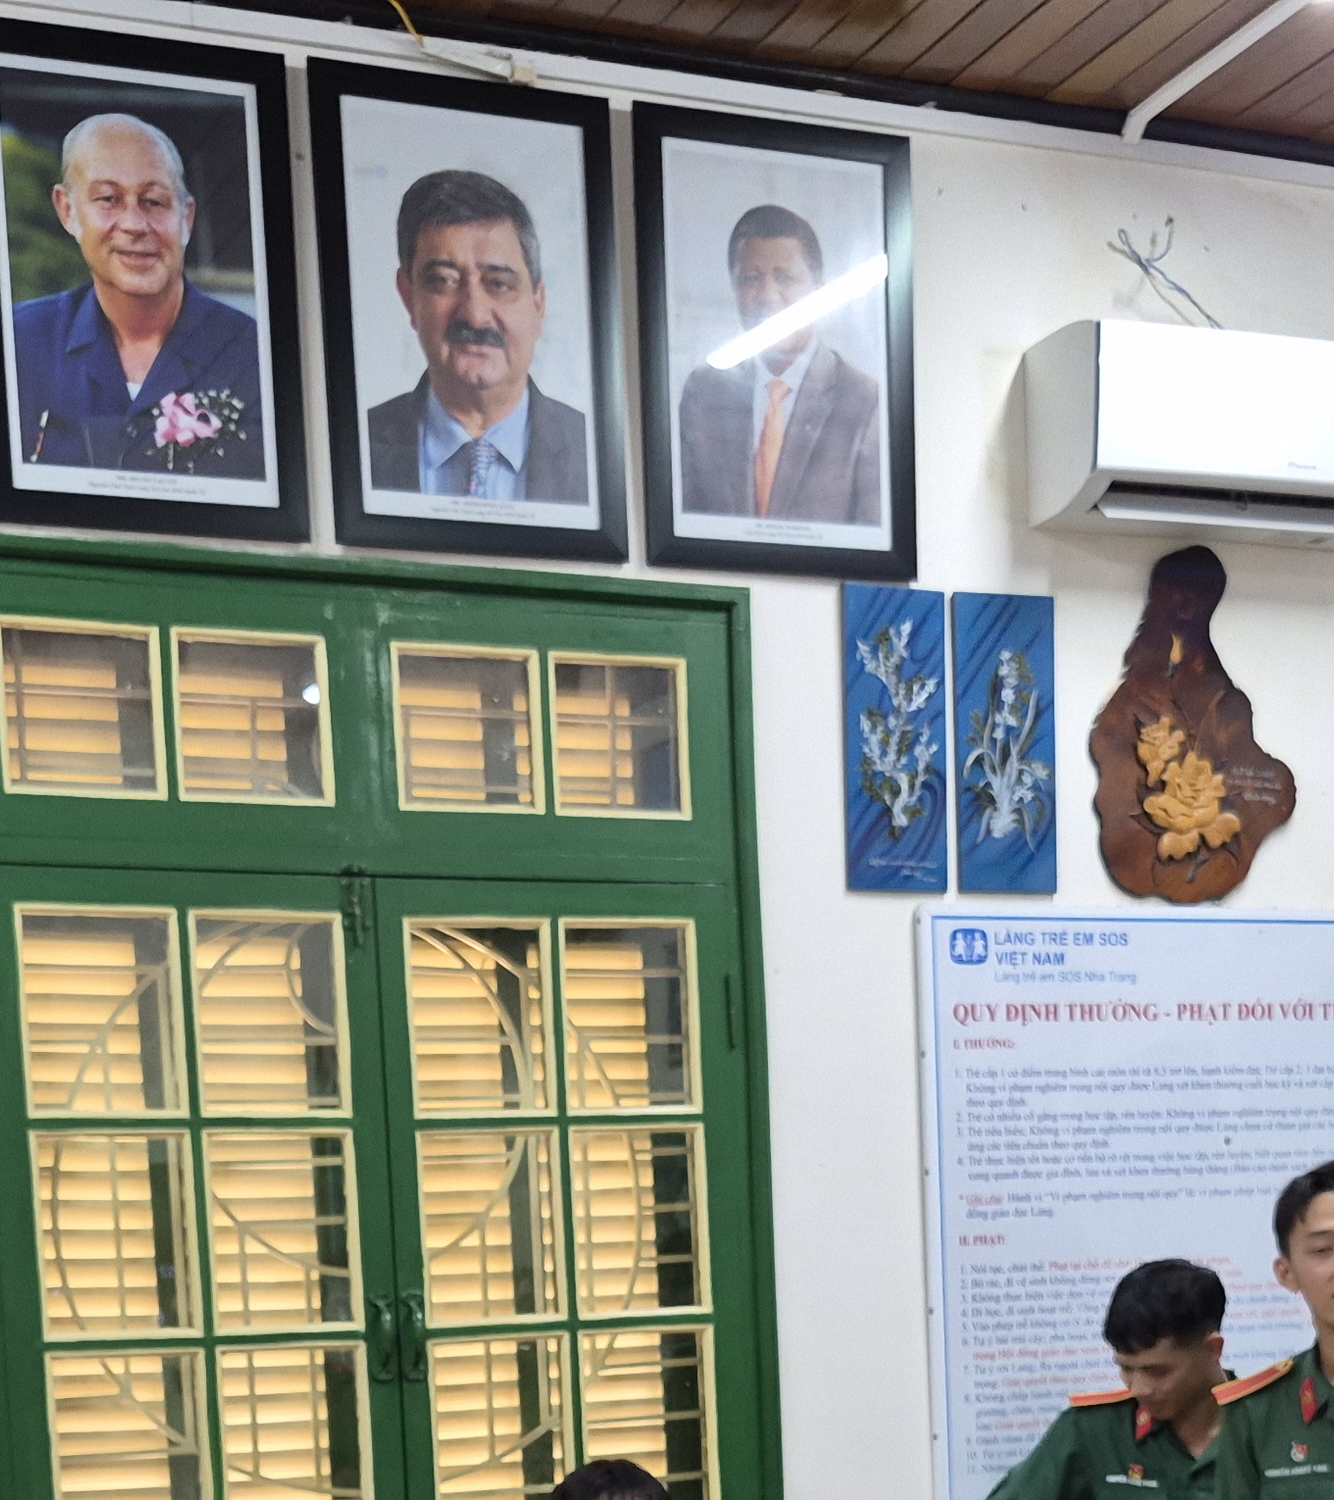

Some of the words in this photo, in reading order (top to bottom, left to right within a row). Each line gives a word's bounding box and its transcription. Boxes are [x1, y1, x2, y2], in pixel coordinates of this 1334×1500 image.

[993, 928, 1035, 946] LÀNG
[1041, 930, 1068, 946] TRẺ
[1073, 932, 1093, 946] EM
[1098, 932, 1128, 947] SOS
[995, 951, 1028, 969] VIỆT
[1032, 952, 1065, 966] NAM
[1059, 971, 1082, 983] SOS
[1084, 972, 1105, 983] Nha
[1108, 971, 1137, 984] Trang
[952, 1003, 997, 1026] QUY
[1005, 1003, 1060, 1026] ĐỊNH
[1066, 999, 1158, 1023] THƯỞNG
[1177, 1003, 1231, 1026] PHẠT
[1279, 995, 1314, 1021] VỚI
